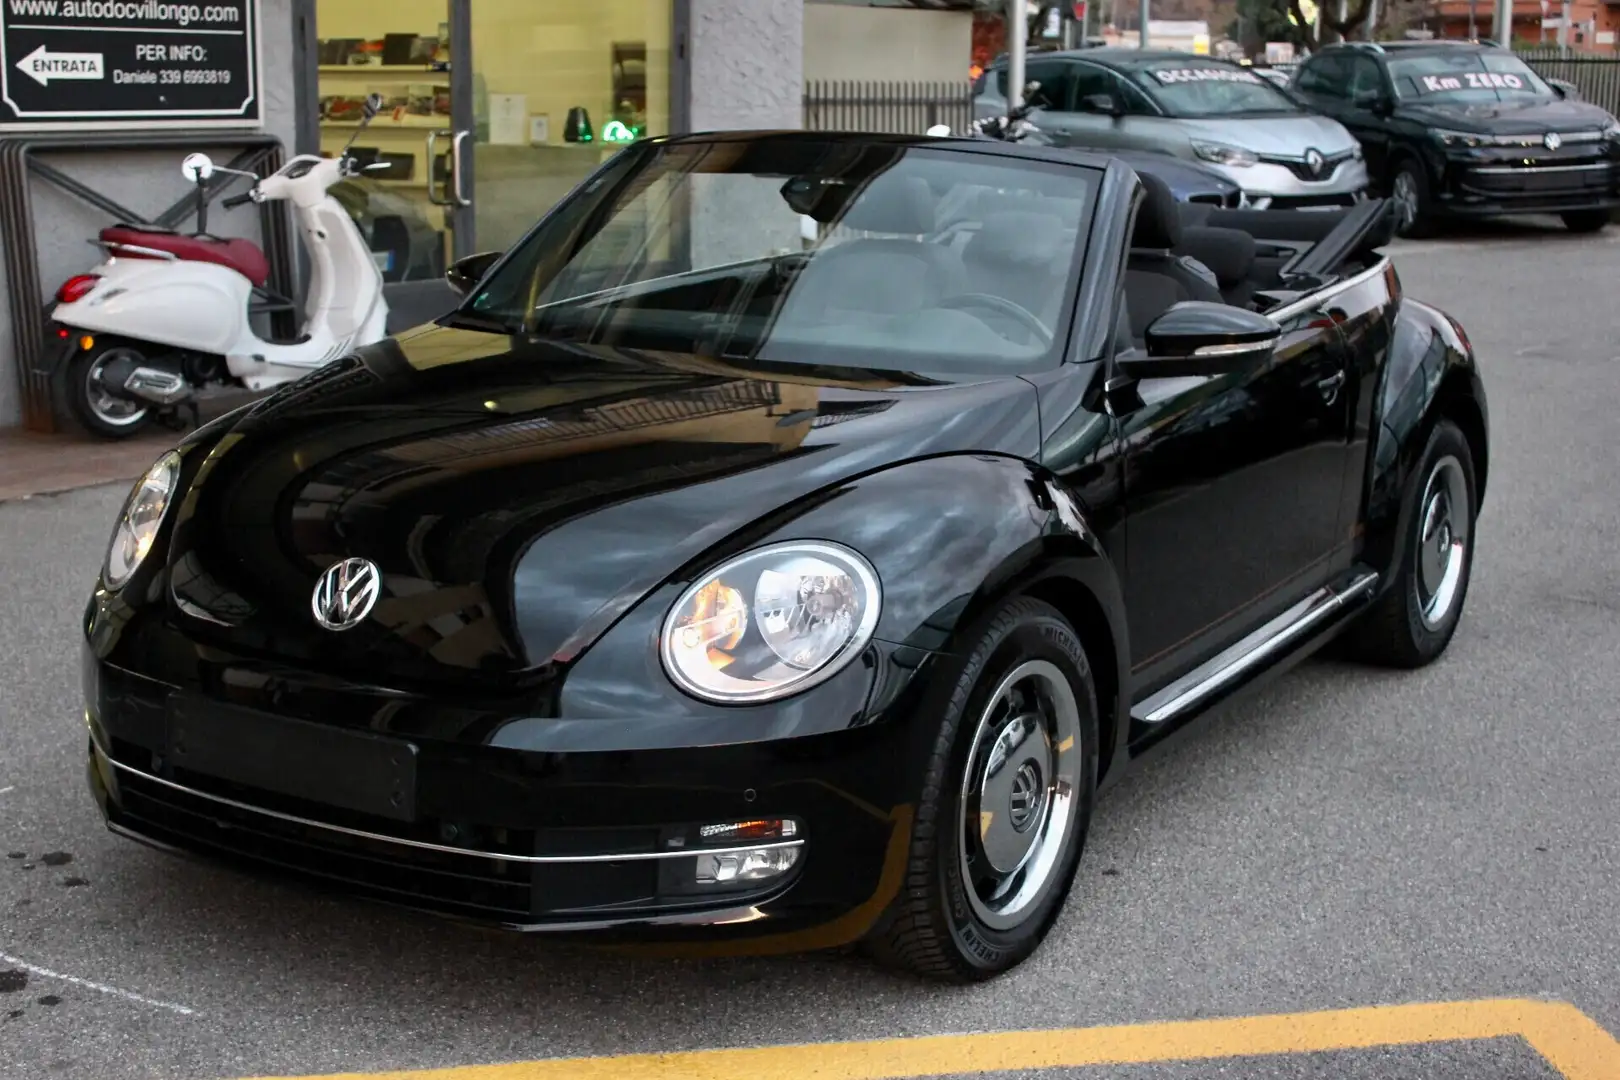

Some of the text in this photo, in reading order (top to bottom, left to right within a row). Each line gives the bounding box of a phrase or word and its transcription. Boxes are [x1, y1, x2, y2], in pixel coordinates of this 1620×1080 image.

[9, 0, 239, 26] www.autodocvillongo.com
[136, 44, 207, 62] PER INFO:
[32, 59, 97, 72] ENTRATA
[113, 69, 157, 84] Daniele
[159, 69, 181, 84] 339
[1422, 72, 1523, 91] Km ZERO
